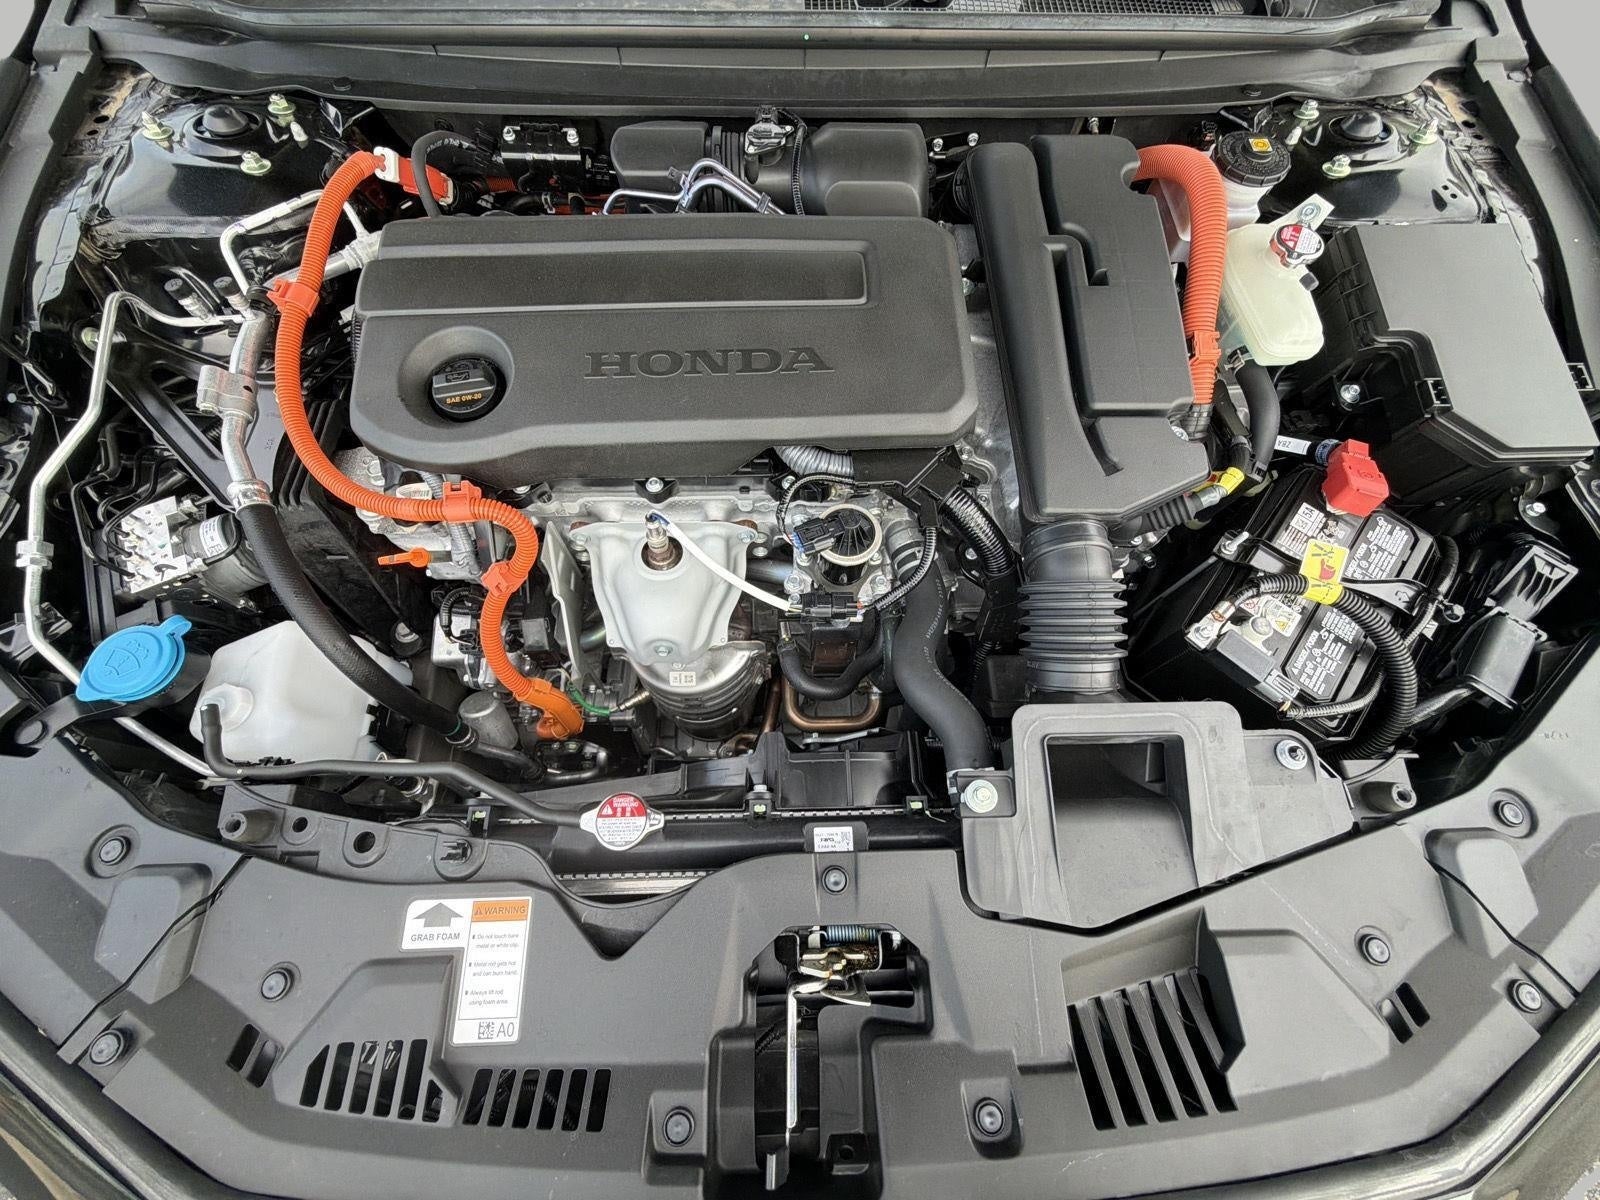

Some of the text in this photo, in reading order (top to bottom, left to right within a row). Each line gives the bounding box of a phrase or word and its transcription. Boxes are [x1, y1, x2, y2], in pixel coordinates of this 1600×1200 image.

[584, 348, 835, 379] HONDA
[446, 393, 482, 404] SAE 0W-20
[484, 905, 526, 915] WARNING
[411, 932, 460, 942] GRAB FOAM
